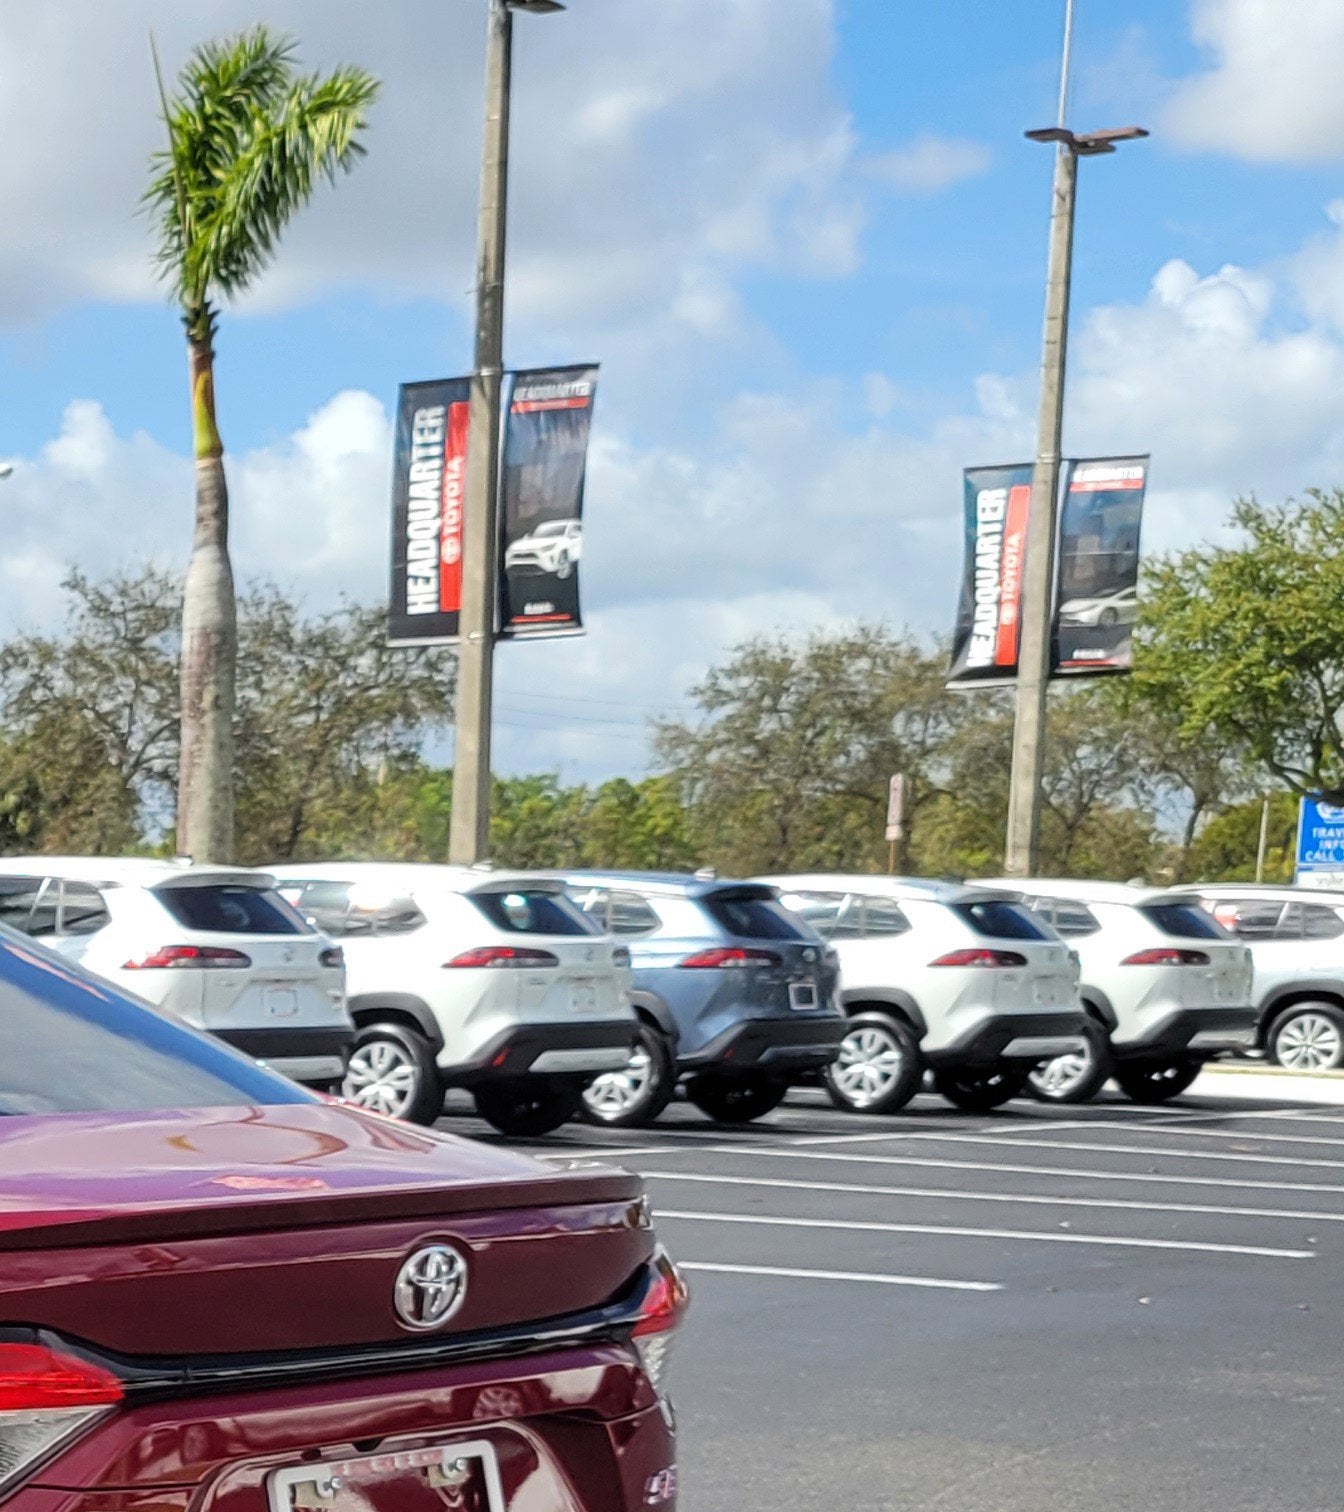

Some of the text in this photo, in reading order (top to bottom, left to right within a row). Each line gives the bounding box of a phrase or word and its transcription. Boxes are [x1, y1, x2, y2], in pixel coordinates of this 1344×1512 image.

[406, 404, 445, 616] HEADQUARTER
[443, 455, 464, 537] TOYOTA
[966, 488, 1007, 668] HEADQUARTER
[1313, 827, 1344, 838] TRAV
